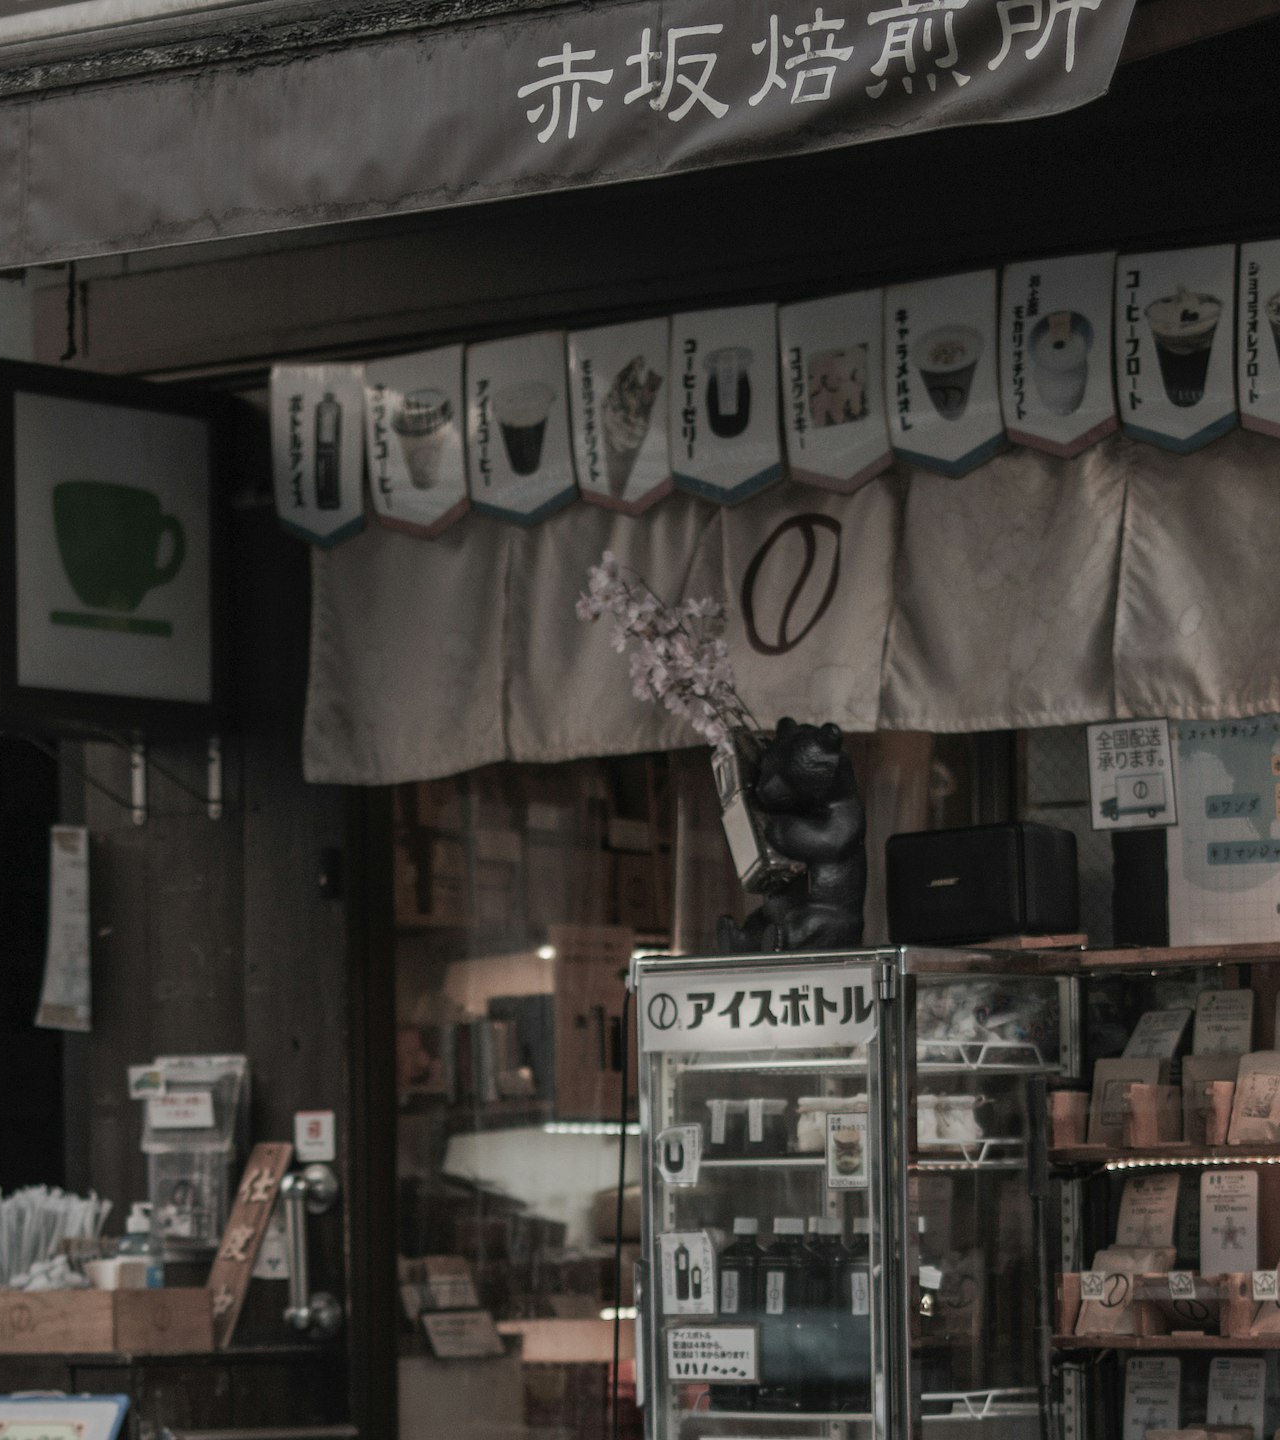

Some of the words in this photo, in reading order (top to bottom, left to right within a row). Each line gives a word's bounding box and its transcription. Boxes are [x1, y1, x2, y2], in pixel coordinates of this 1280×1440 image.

[517, 0, 1104, 143] 赤坂焙煎所
[894, 308, 913, 433] キャラメルオレ
[1125, 270, 1143, 411] コーヒーフロート
[476, 378, 493, 489] アイスコーヒー
[682, 338, 698, 460] コーヒーゼリー
[1095, 726, 1163, 749] 全国配送
[1095, 750, 1166, 771] 承ります。
[686, 984, 874, 1029] アイスボトル
